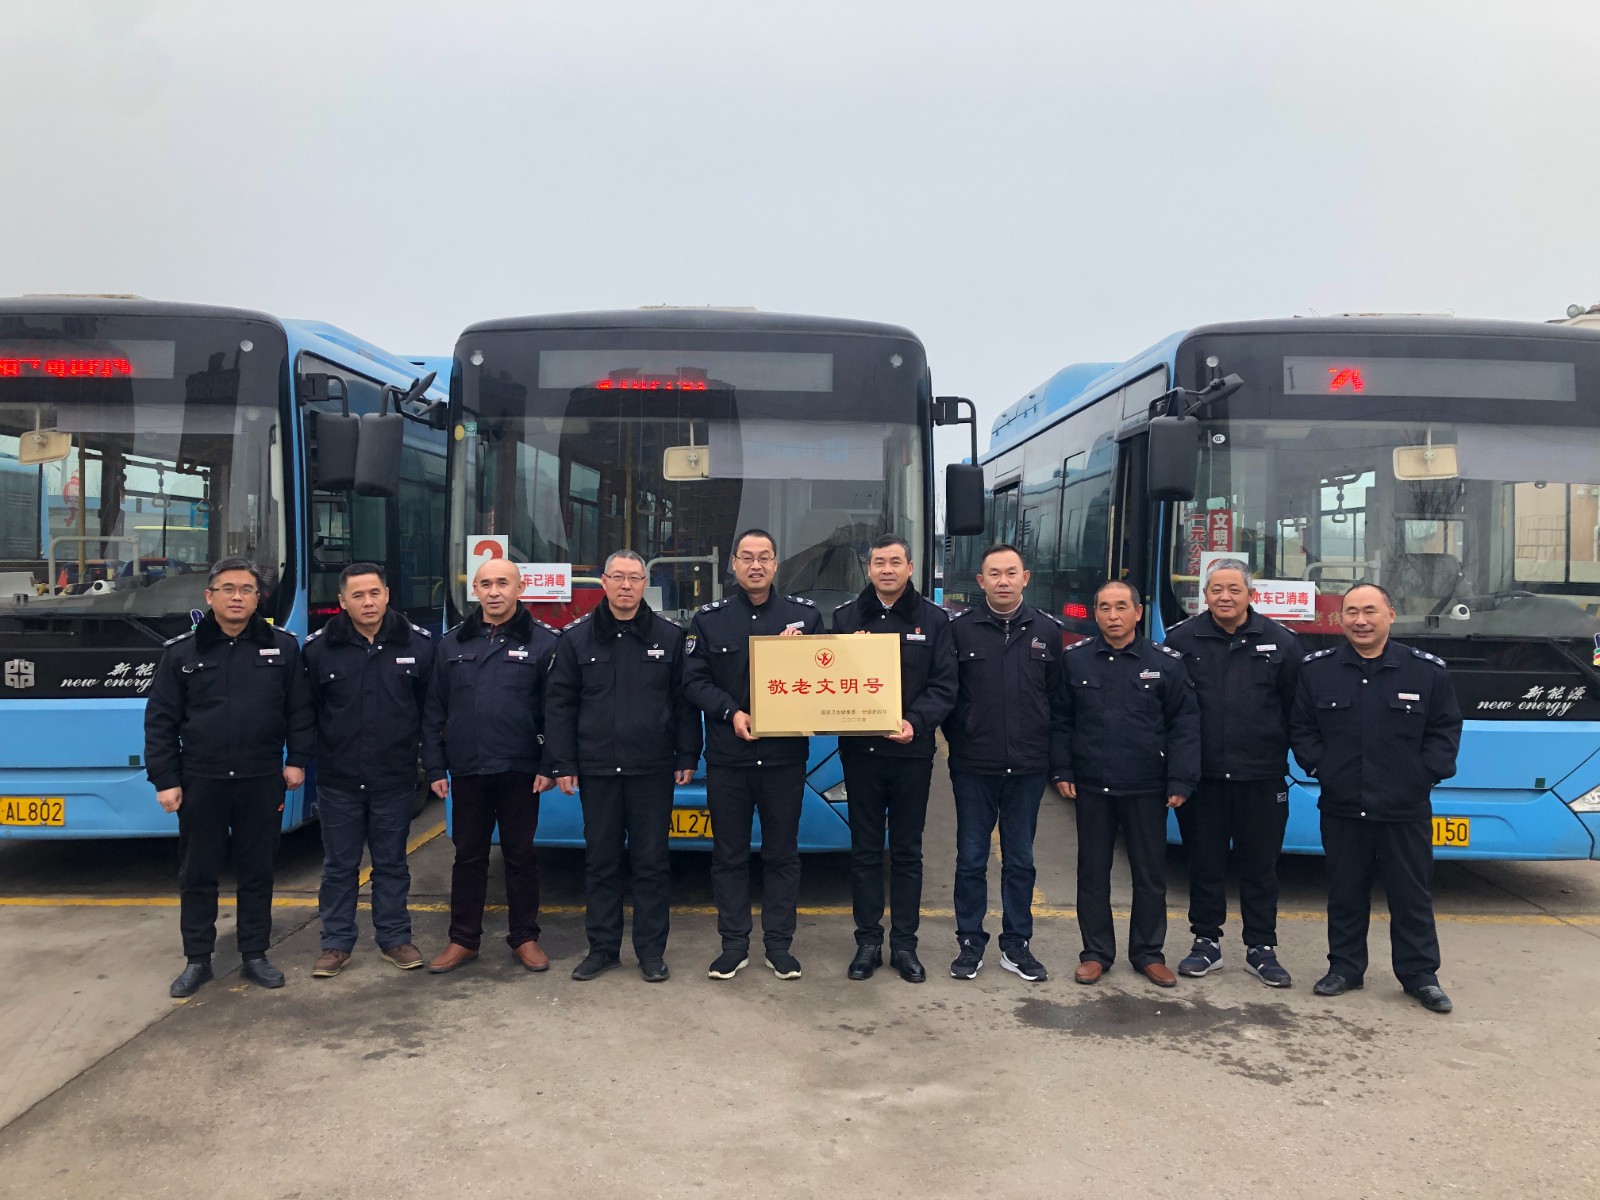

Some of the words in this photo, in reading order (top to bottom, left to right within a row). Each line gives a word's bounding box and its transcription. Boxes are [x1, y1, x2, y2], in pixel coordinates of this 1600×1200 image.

[519, 573, 566, 587] 车已消毒
[1251, 591, 1309, 606] 本车已消毒
[60, 678, 100, 688] new
[767, 677, 884, 695] 敬老文明号
[1522, 685, 1587, 701] 新能源
[1477, 700, 1515, 710] new
[1518, 700, 1575, 717] energy
